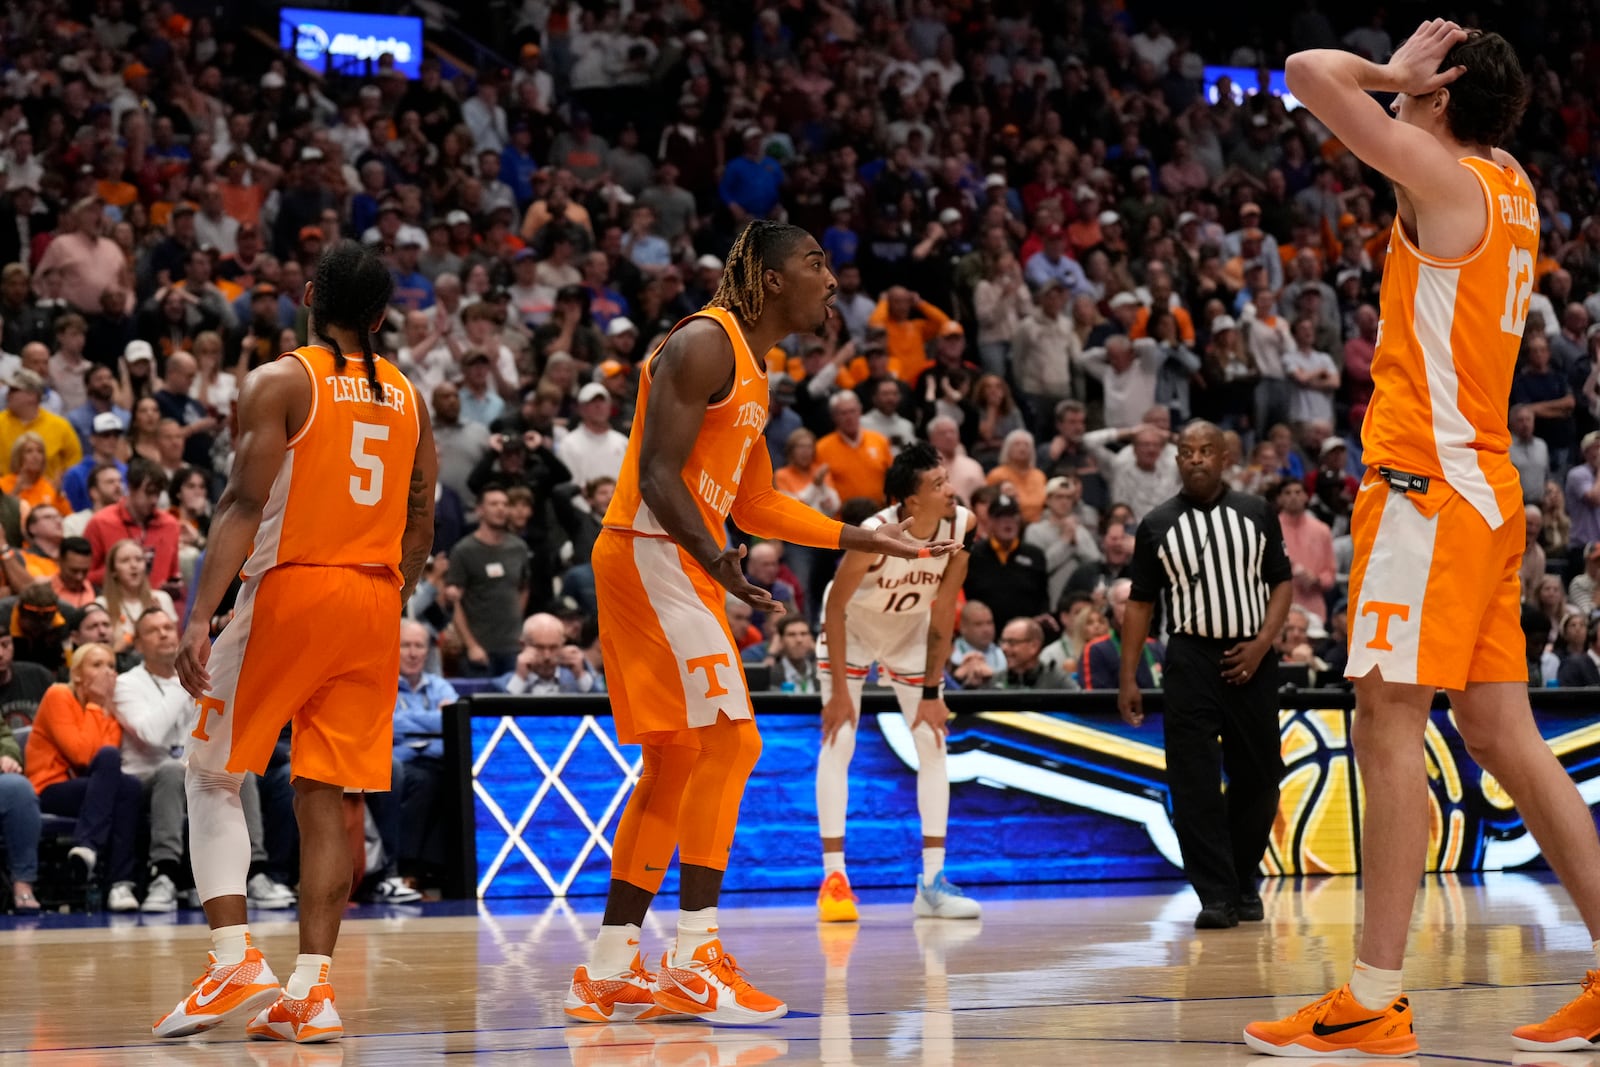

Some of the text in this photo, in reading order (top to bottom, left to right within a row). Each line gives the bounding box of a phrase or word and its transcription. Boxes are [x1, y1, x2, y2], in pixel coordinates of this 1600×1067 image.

[1501, 244, 1534, 338] 12
[349, 420, 390, 507] 5
[883, 592, 921, 613] 10
[1361, 600, 1410, 652] T
[685, 653, 730, 699] T
